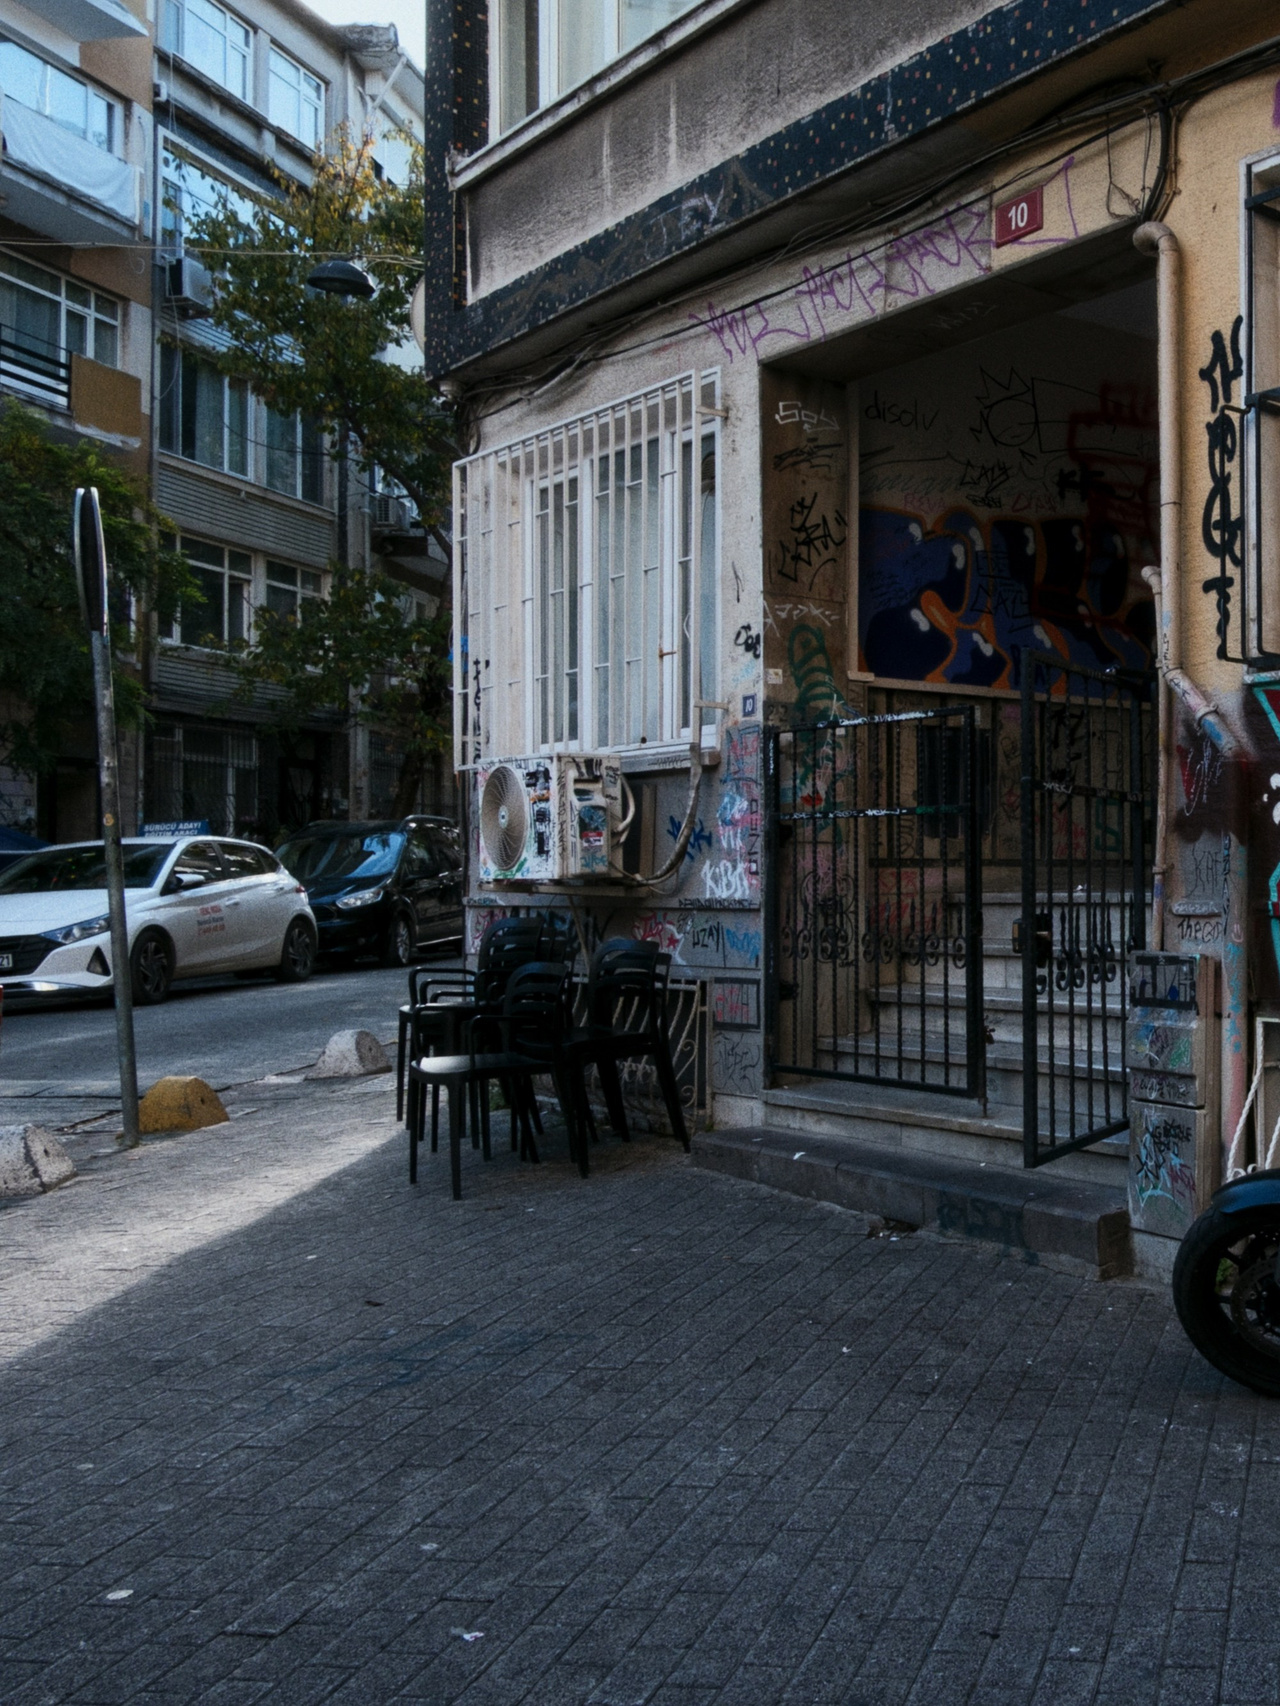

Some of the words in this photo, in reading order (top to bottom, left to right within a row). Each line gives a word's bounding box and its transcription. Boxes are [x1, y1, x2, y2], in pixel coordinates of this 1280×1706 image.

[1007, 202, 1029, 230] 10
[745, 699, 754, 712] 10
[143, 821, 177, 832] SÜRÜCÜ
[177, 821, 202, 830] ADAYI
